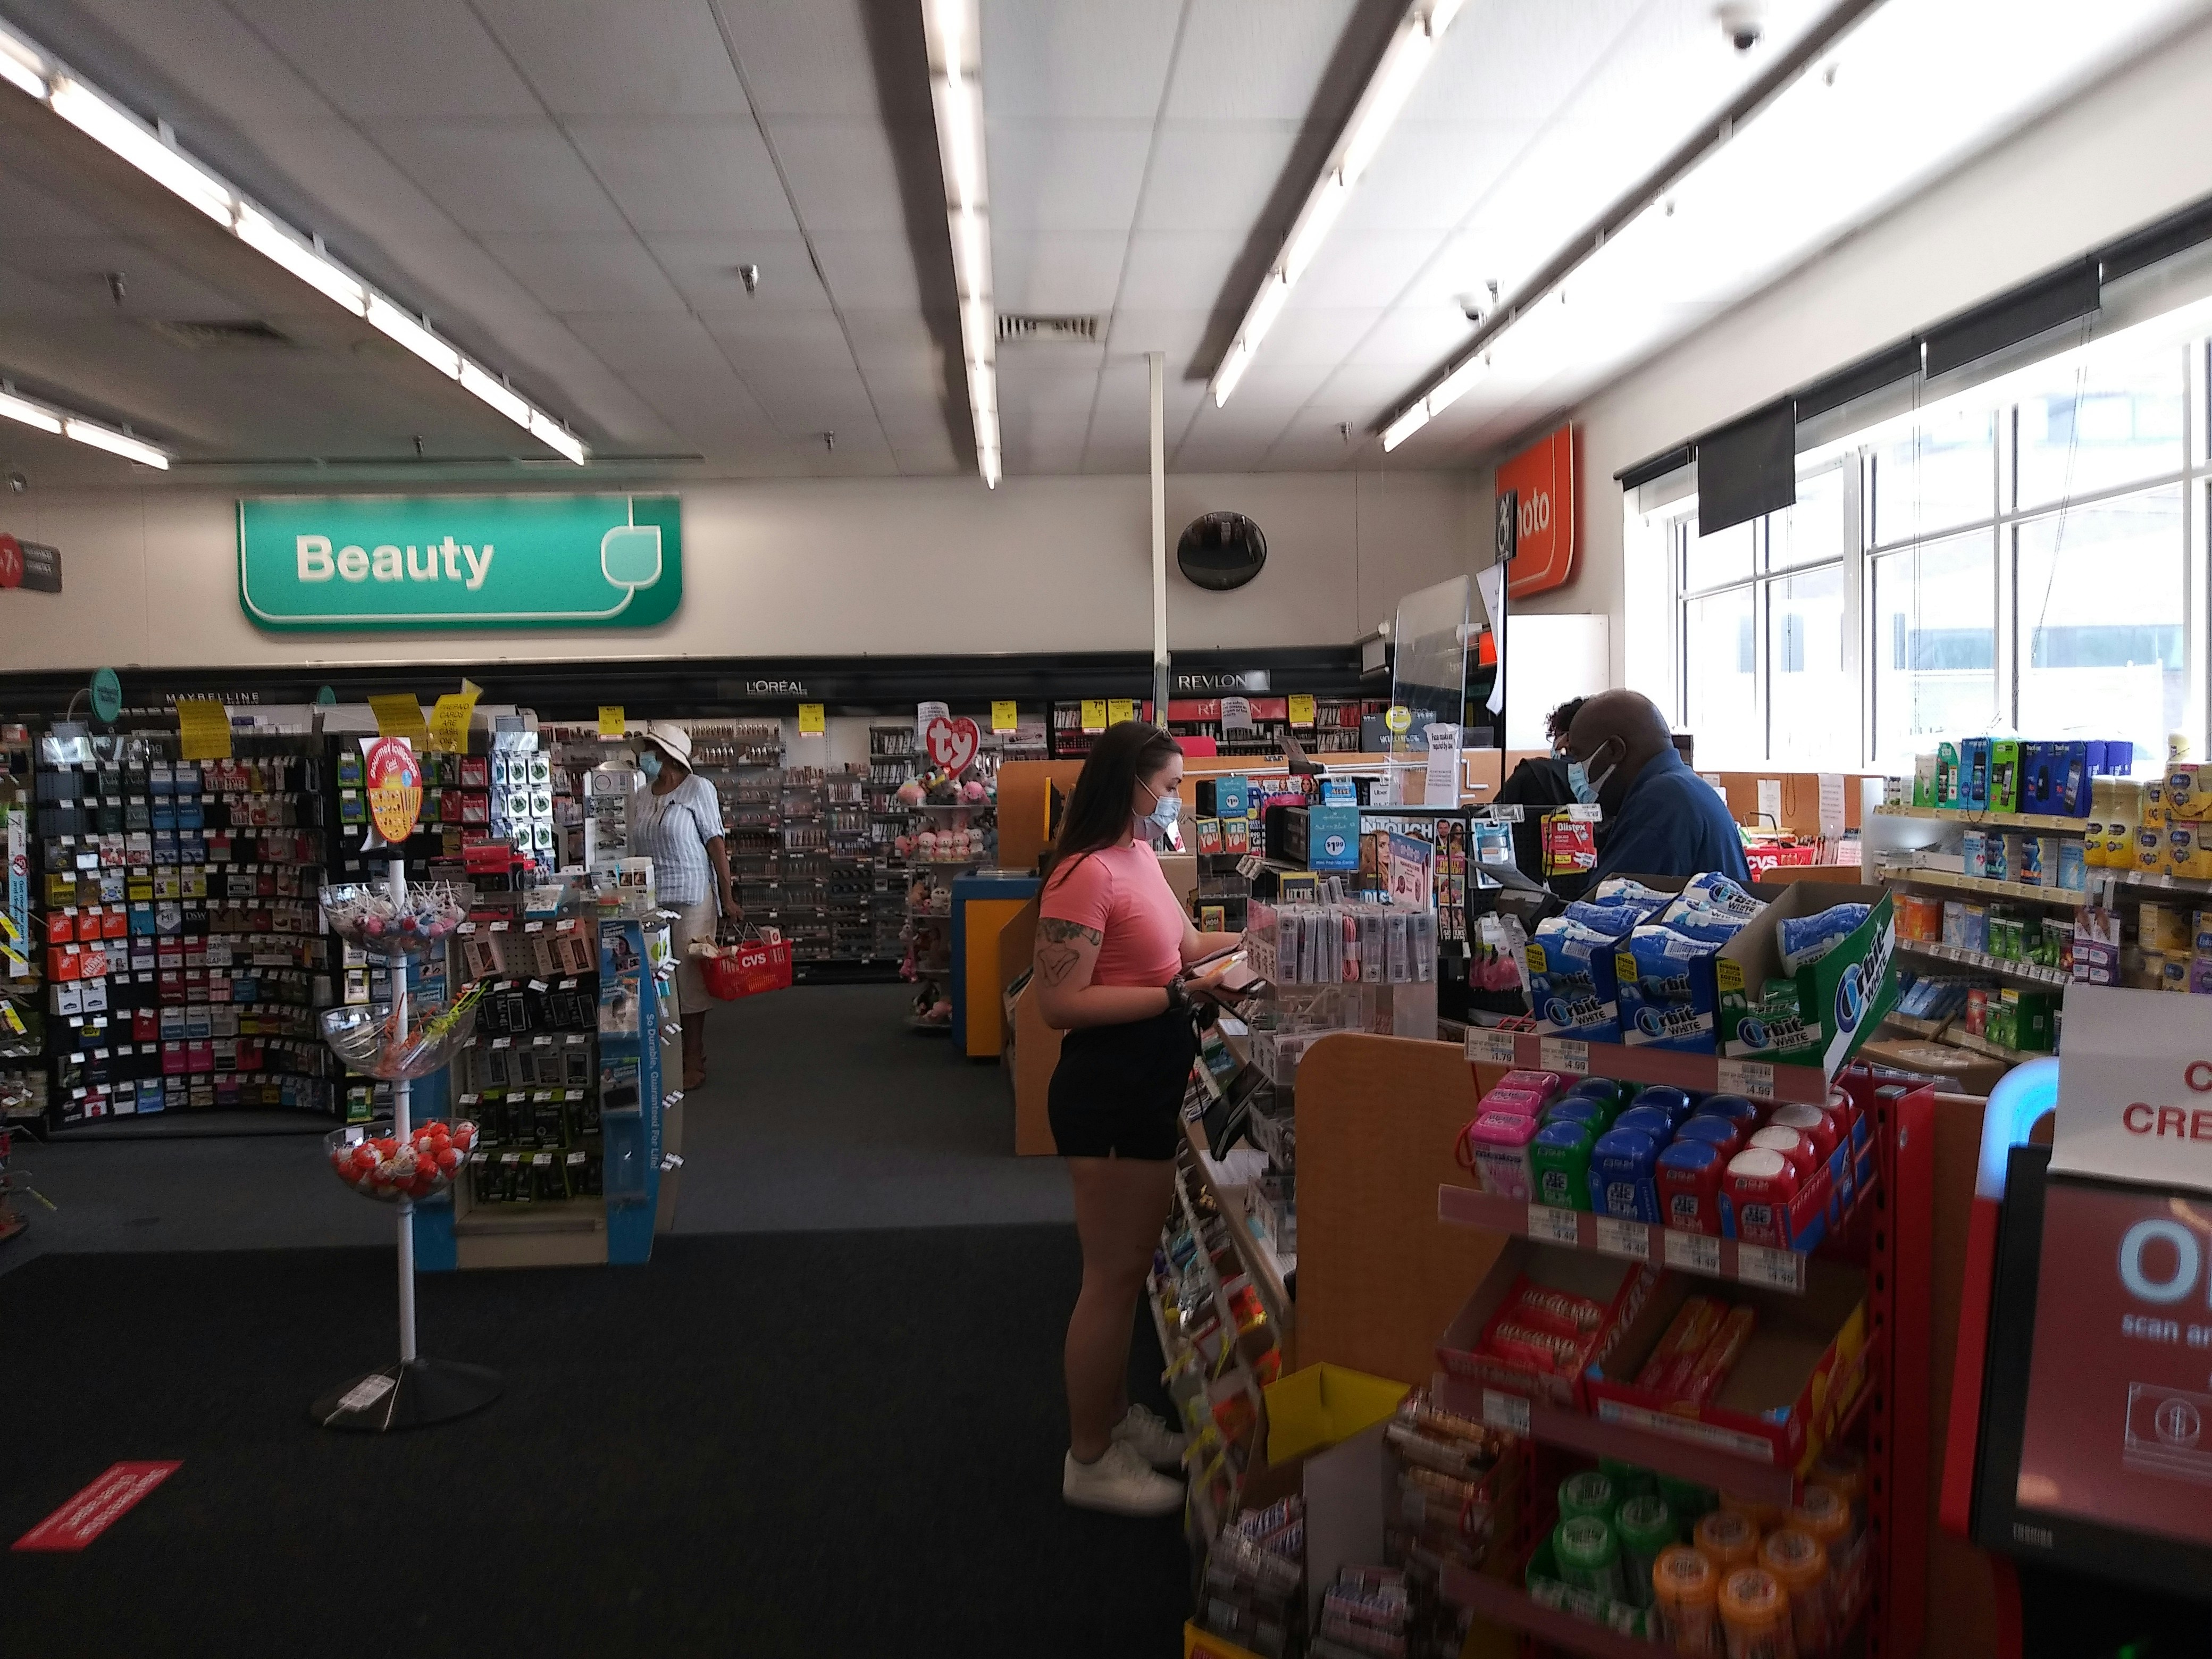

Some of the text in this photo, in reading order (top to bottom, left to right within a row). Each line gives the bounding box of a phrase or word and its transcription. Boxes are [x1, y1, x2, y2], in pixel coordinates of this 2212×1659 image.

[297, 535, 494, 591] Beauty
[1178, 674, 1247, 690] REVLON
[929, 719, 973, 770] ty
[1202, 823, 1217, 834] BE
[1230, 823, 1245, 834] BE
[1557, 822, 1586, 832] Blistex
[1200, 833, 1219, 848] YOU
[1228, 833, 1246, 848] YOU
[186, 912, 206, 920] DSW
[742, 953, 767, 967] CVS
[1544, 993, 1602, 1027] Orbit
[1576, 1010, 1606, 1026] WHITE
[1634, 1003, 1697, 1037] Orbit
[1668, 1021, 1702, 1036] WHITE
[1737, 1014, 1805, 1048] Orbit
[1773, 1032, 1808, 1047] WHITE
